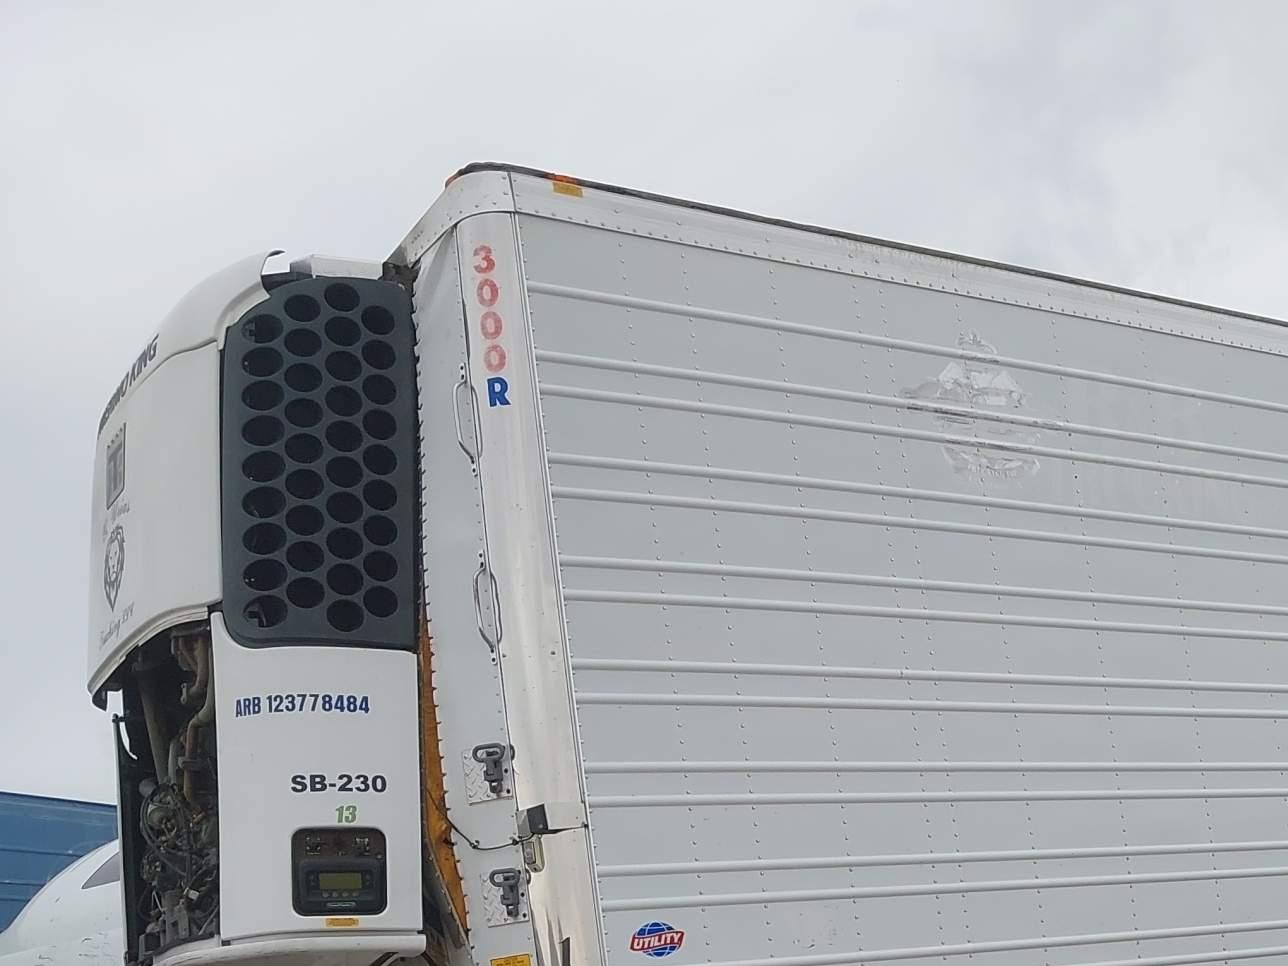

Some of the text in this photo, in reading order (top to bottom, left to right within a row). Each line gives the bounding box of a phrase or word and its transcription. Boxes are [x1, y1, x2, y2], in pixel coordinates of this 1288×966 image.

[473, 245, 511, 408] 3000R
[129, 333, 159, 387] KING
[235, 693, 370, 717] ARB 123778484
[291, 774, 387, 793] SB-230
[335, 805, 357, 824] 13
[633, 932, 682, 950] UTILITY
